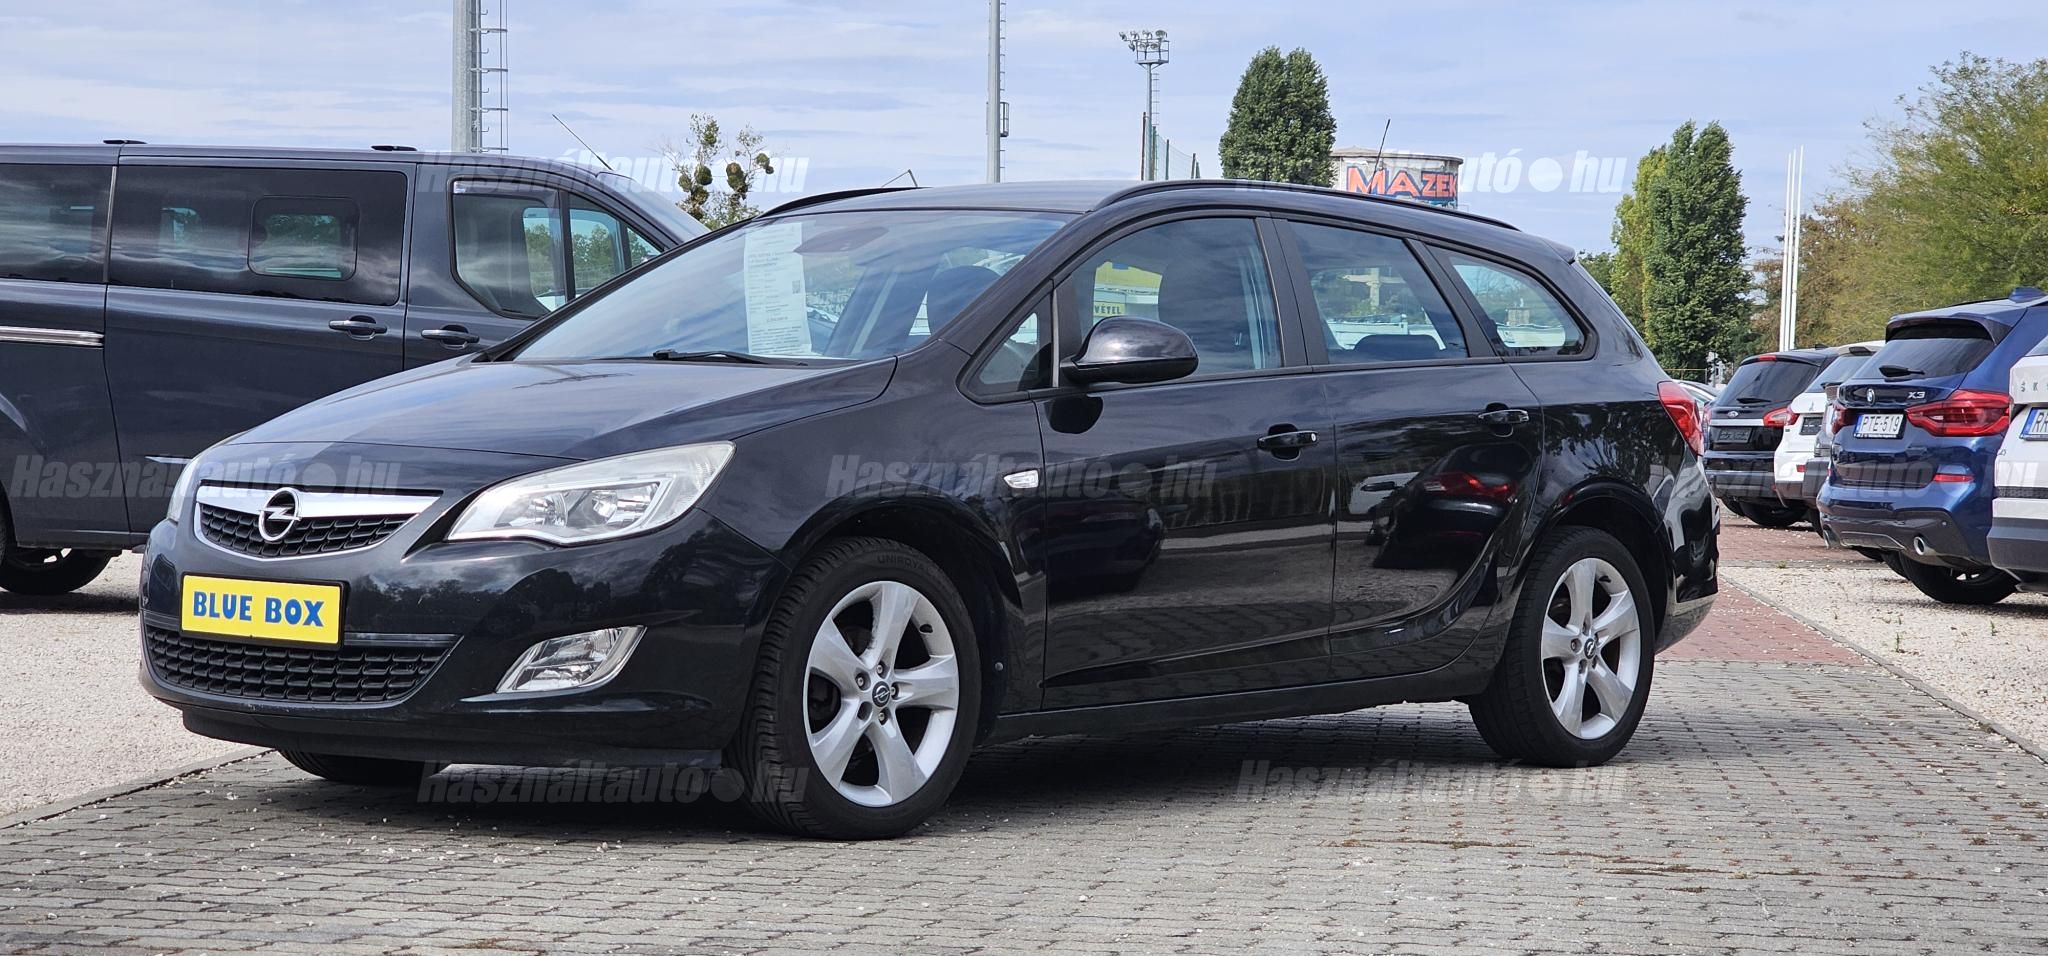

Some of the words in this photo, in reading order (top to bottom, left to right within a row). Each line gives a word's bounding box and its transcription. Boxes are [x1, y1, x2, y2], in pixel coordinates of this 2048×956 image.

[1907, 391, 1926, 399] X3
[1861, 415, 1900, 432] PTE-519
[193, 591, 252, 621] BLUE
[264, 597, 324, 627] BOX
